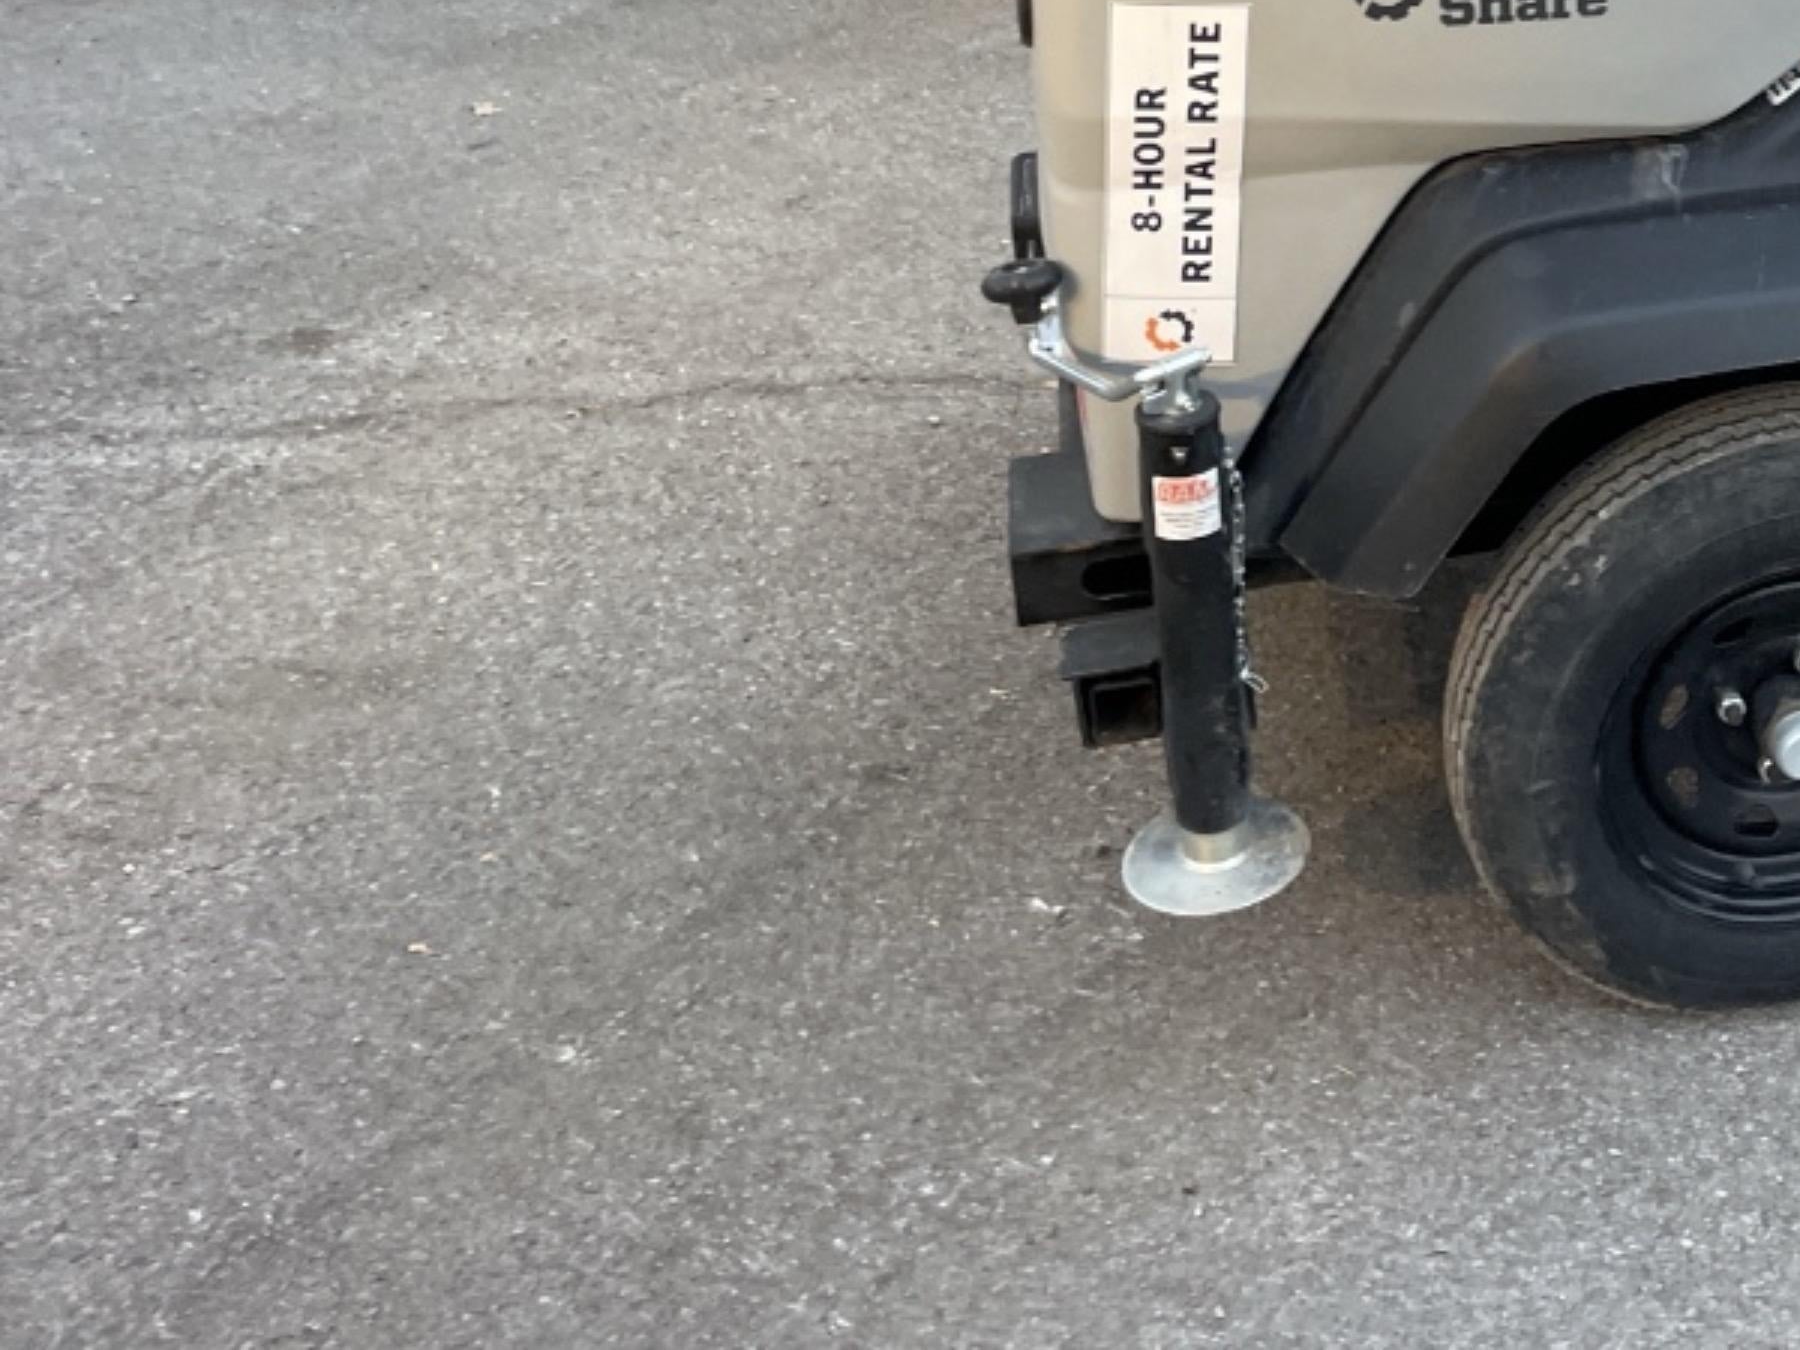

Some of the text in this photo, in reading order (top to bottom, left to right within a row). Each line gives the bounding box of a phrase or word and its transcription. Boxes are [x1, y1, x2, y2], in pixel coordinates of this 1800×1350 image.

[1131, 86, 1168, 232] 8-HOUR
[1181, 22, 1222, 283] RENTAL RATE
